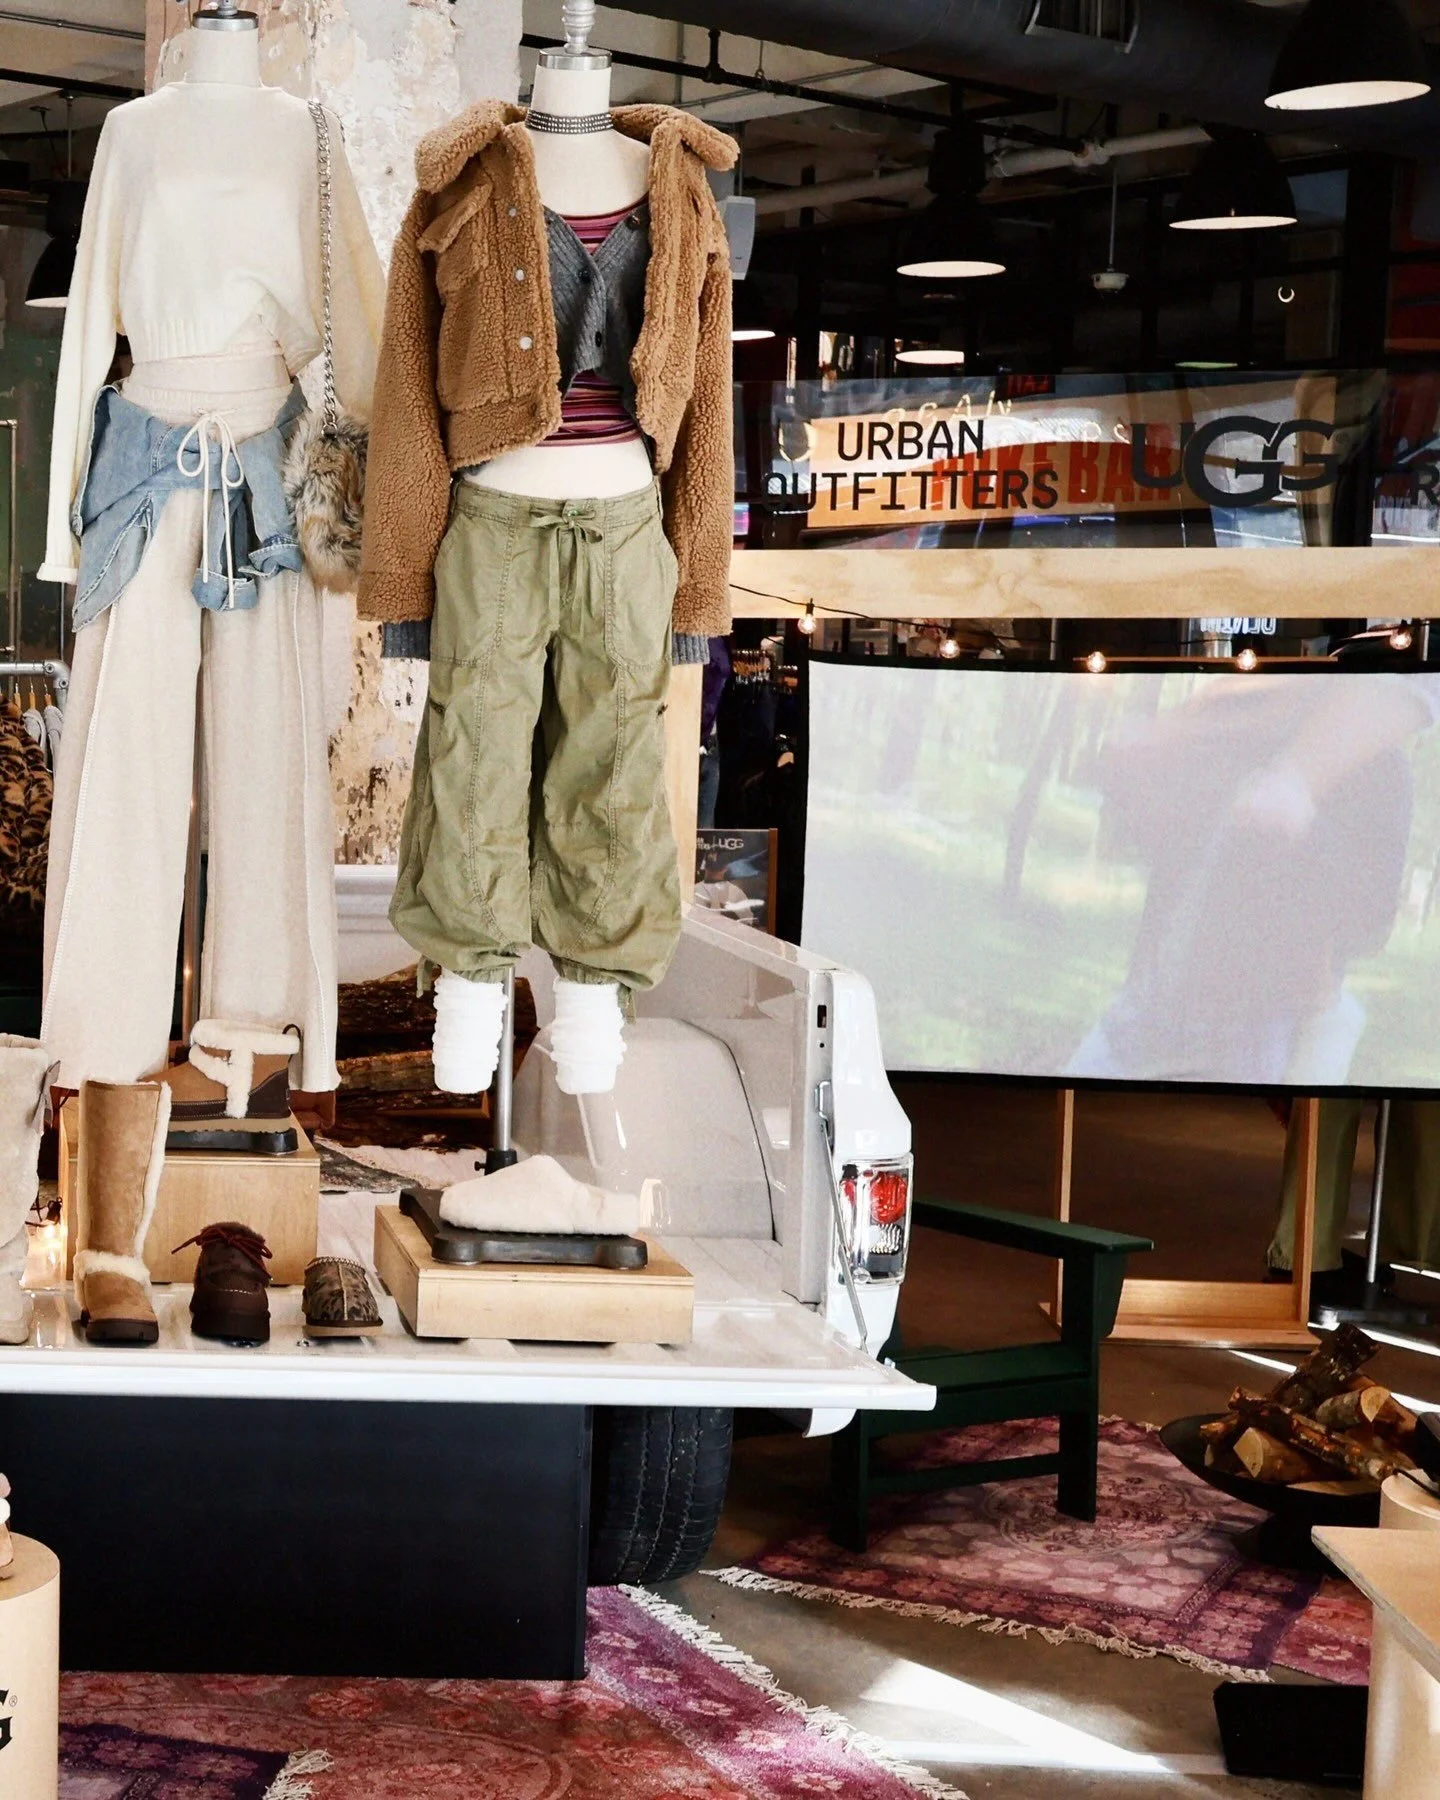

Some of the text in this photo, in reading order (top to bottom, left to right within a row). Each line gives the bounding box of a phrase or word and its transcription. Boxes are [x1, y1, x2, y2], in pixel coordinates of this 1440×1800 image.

[837, 419, 984, 461] URBAN
[1130, 415, 1341, 508] UGG
[762, 468, 1059, 511] OUTFITTERS
